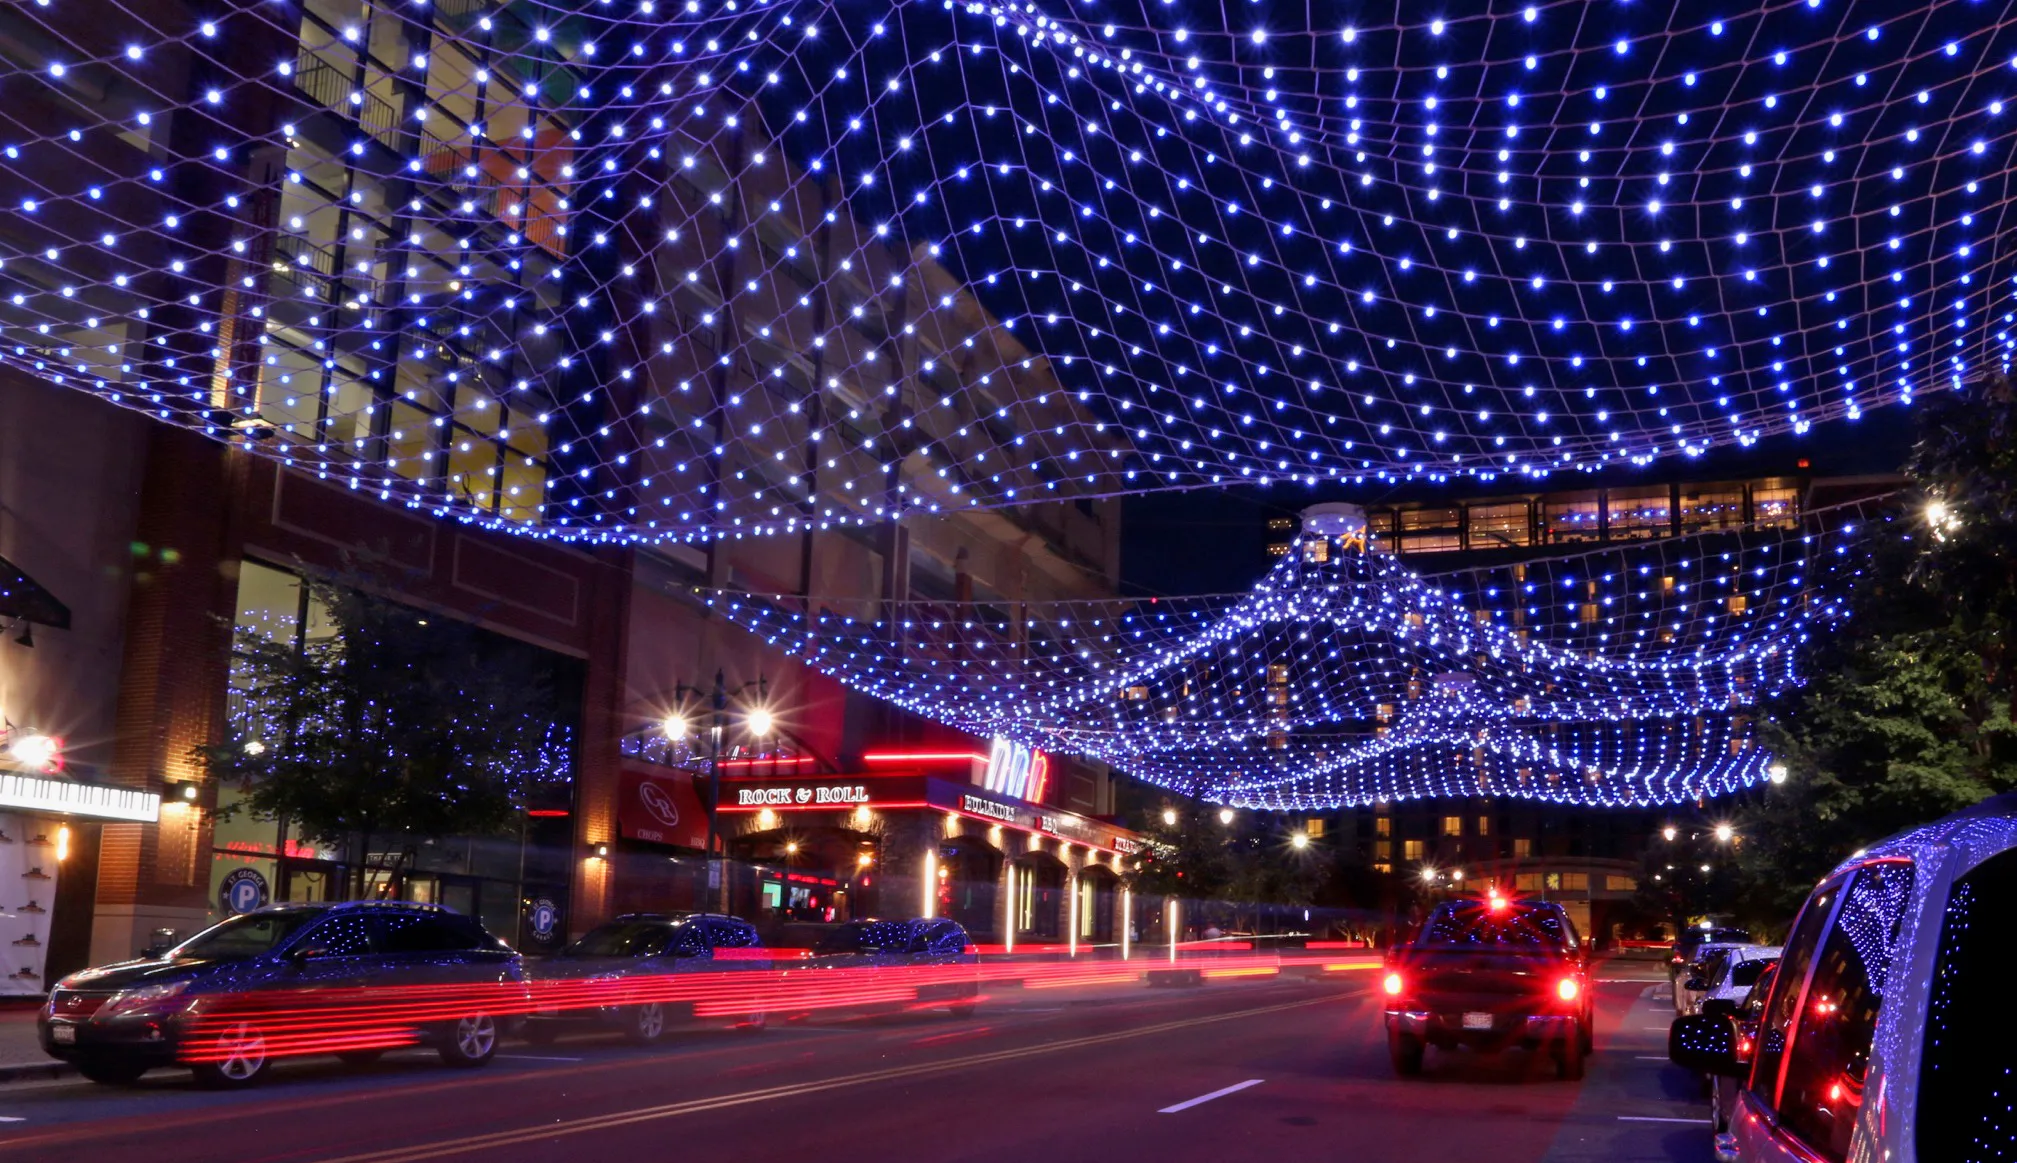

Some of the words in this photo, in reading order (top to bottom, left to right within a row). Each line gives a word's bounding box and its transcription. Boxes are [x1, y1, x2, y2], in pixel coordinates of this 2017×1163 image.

[739, 789, 792, 805] ROCK
[796, 787, 812, 803] &
[816, 786, 869, 803] ROLL
[238, 870, 264, 887] GEORGE
[238, 885, 255, 909] P
[540, 910, 550, 930] P
